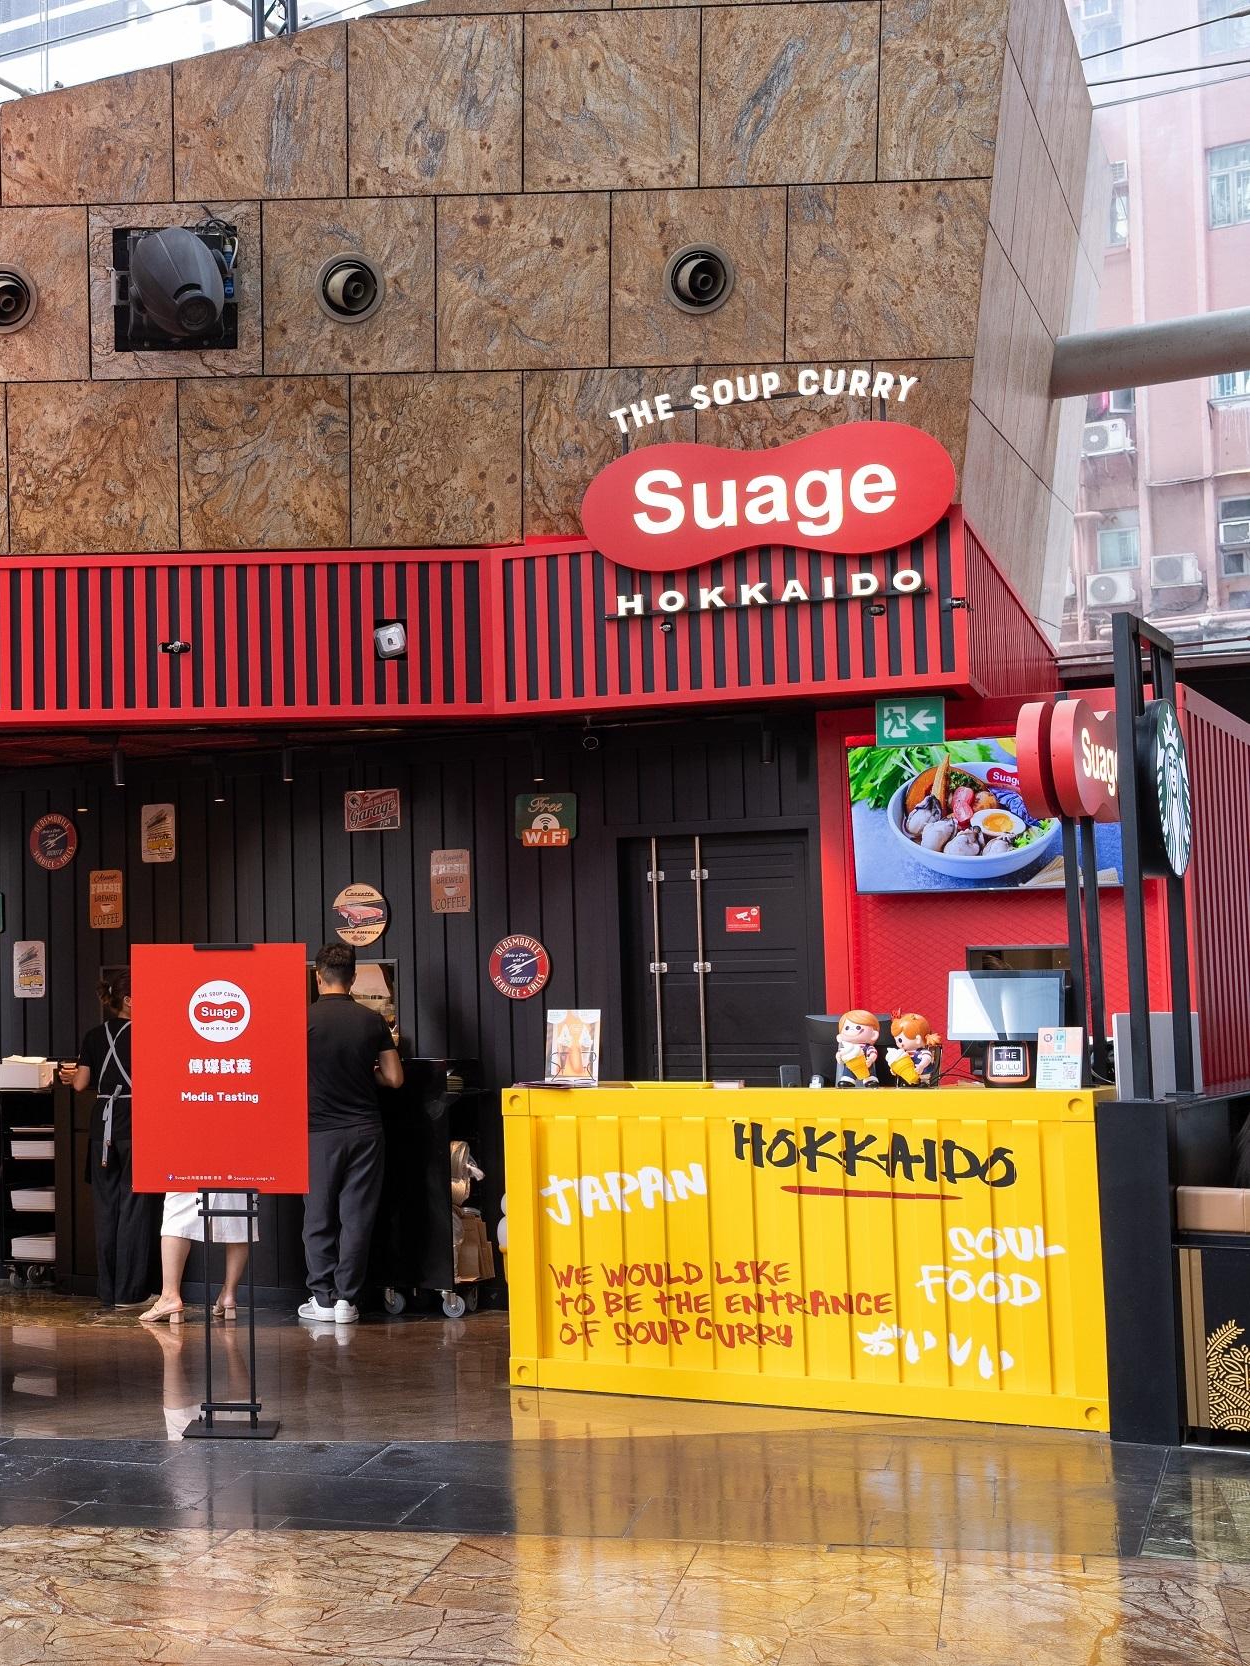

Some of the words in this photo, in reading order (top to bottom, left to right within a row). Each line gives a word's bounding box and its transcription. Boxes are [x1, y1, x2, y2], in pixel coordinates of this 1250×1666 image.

[609, 393, 675, 434] THE
[690, 370, 781, 411] SOUP
[797, 369, 919, 402] CURRY
[632, 463, 897, 537] Suage
[617, 569, 923, 617] HOKKAIDO
[1081, 727, 1117, 797] Suag
[350, 799, 397, 829] Garage
[527, 796, 563, 813] Free
[436, 876, 464, 884] BREWED
[94, 895, 118, 903] BREWED
[435, 896, 467, 911] COFFEE
[93, 912, 120, 926] COFFEE
[495, 937, 541, 956] OLDSMOBILE
[494, 976, 521, 997] SERVICE
[527, 973, 545, 994] SALES
[201, 1006, 238, 1019] Suage
[995, 1063, 1020, 1071] GULU
[998, 1051, 1017, 1059] THE
[181, 1091, 214, 1102] Media
[216, 1091, 259, 1104] Tasting
[732, 1119, 1017, 1187] HOKKAIDO
[541, 1162, 708, 1226] JAPAN
[947, 1225, 1066, 1262] SOUL
[549, 1263, 593, 1288] WE
[601, 1261, 704, 1287] WOULD
[714, 1260, 792, 1286] LIKE
[915, 1265, 1042, 1307] FOOD
[604, 1291, 642, 1316] BE
[559, 1321, 601, 1348] OF
[614, 1320, 690, 1347] SOUP
[694, 1319, 793, 1349] CURRY
[857, 1321, 1015, 1380] おいしい
